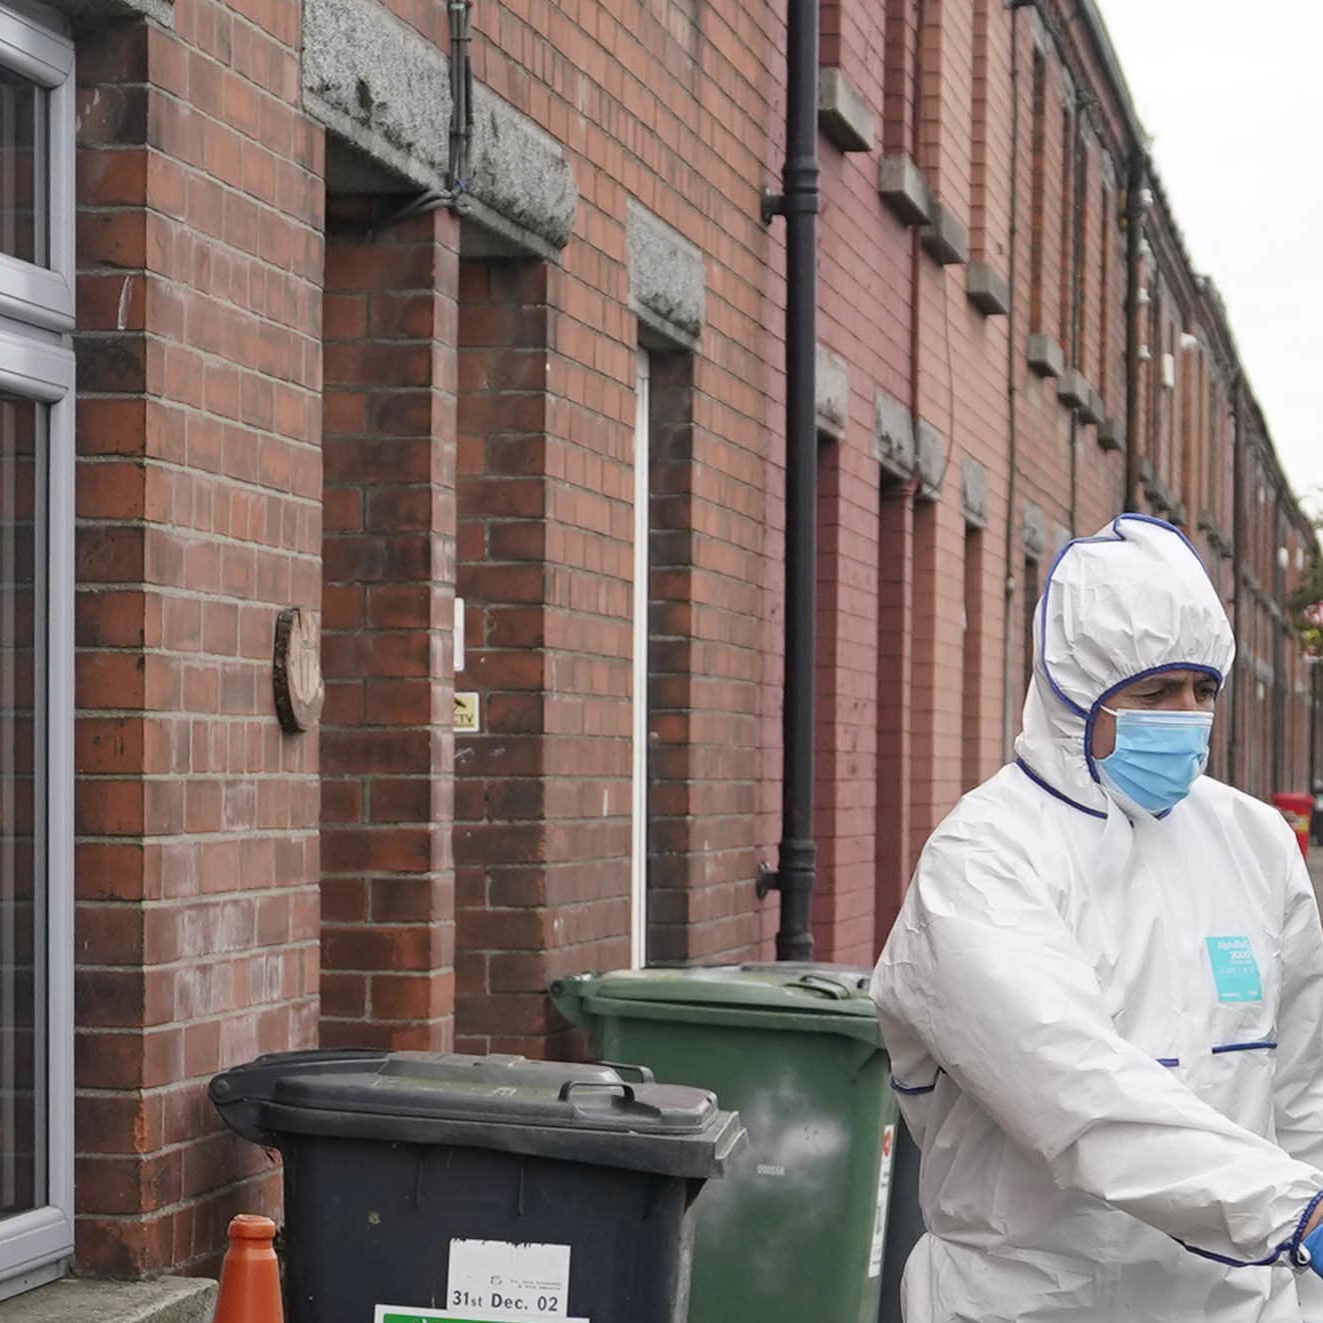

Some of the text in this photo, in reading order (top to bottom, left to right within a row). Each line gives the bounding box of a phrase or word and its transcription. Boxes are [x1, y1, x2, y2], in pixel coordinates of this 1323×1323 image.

[452, 1290, 558, 1312] 31st Dec. 02
